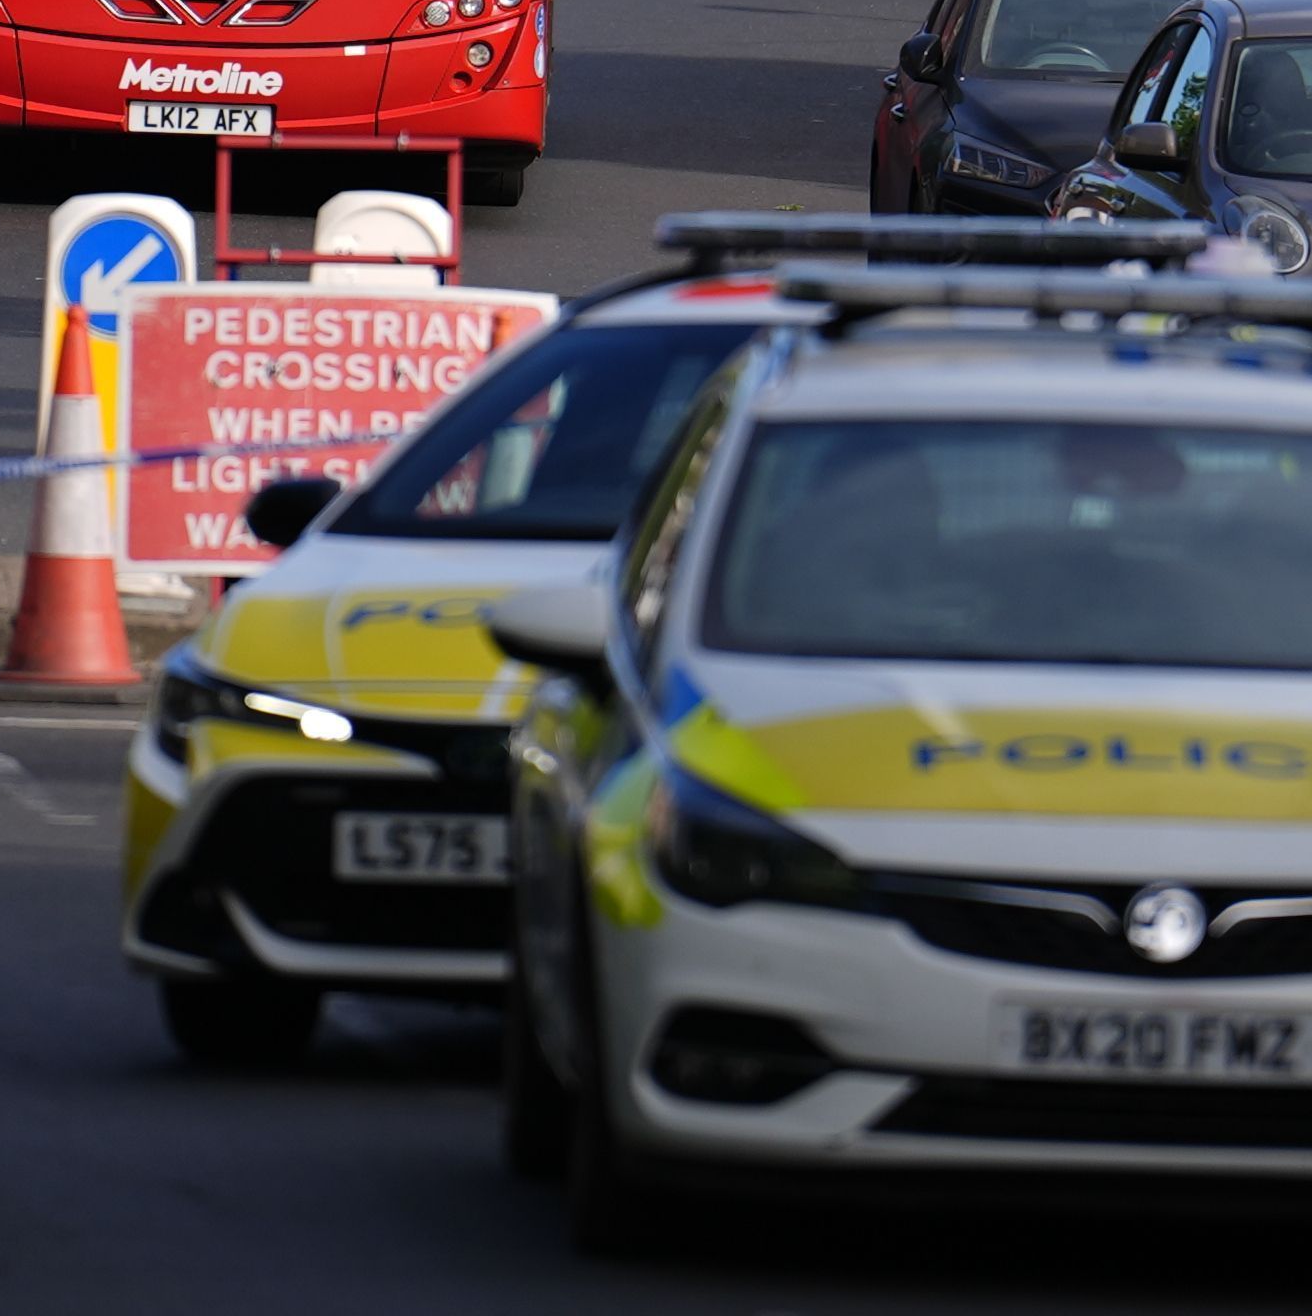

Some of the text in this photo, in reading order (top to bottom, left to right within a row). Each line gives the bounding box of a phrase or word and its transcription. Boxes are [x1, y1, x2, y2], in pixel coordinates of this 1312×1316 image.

[118, 57, 283, 97] Metroline
[144, 106, 257, 132] LK12 AFX
[185, 307, 493, 352] PEDESTRIAN
[205, 350, 470, 396] CROSSING
[208, 406, 353, 445] WHEN
[349, 826, 482, 870] LS75
[1020, 1010, 1168, 1071] BX20
